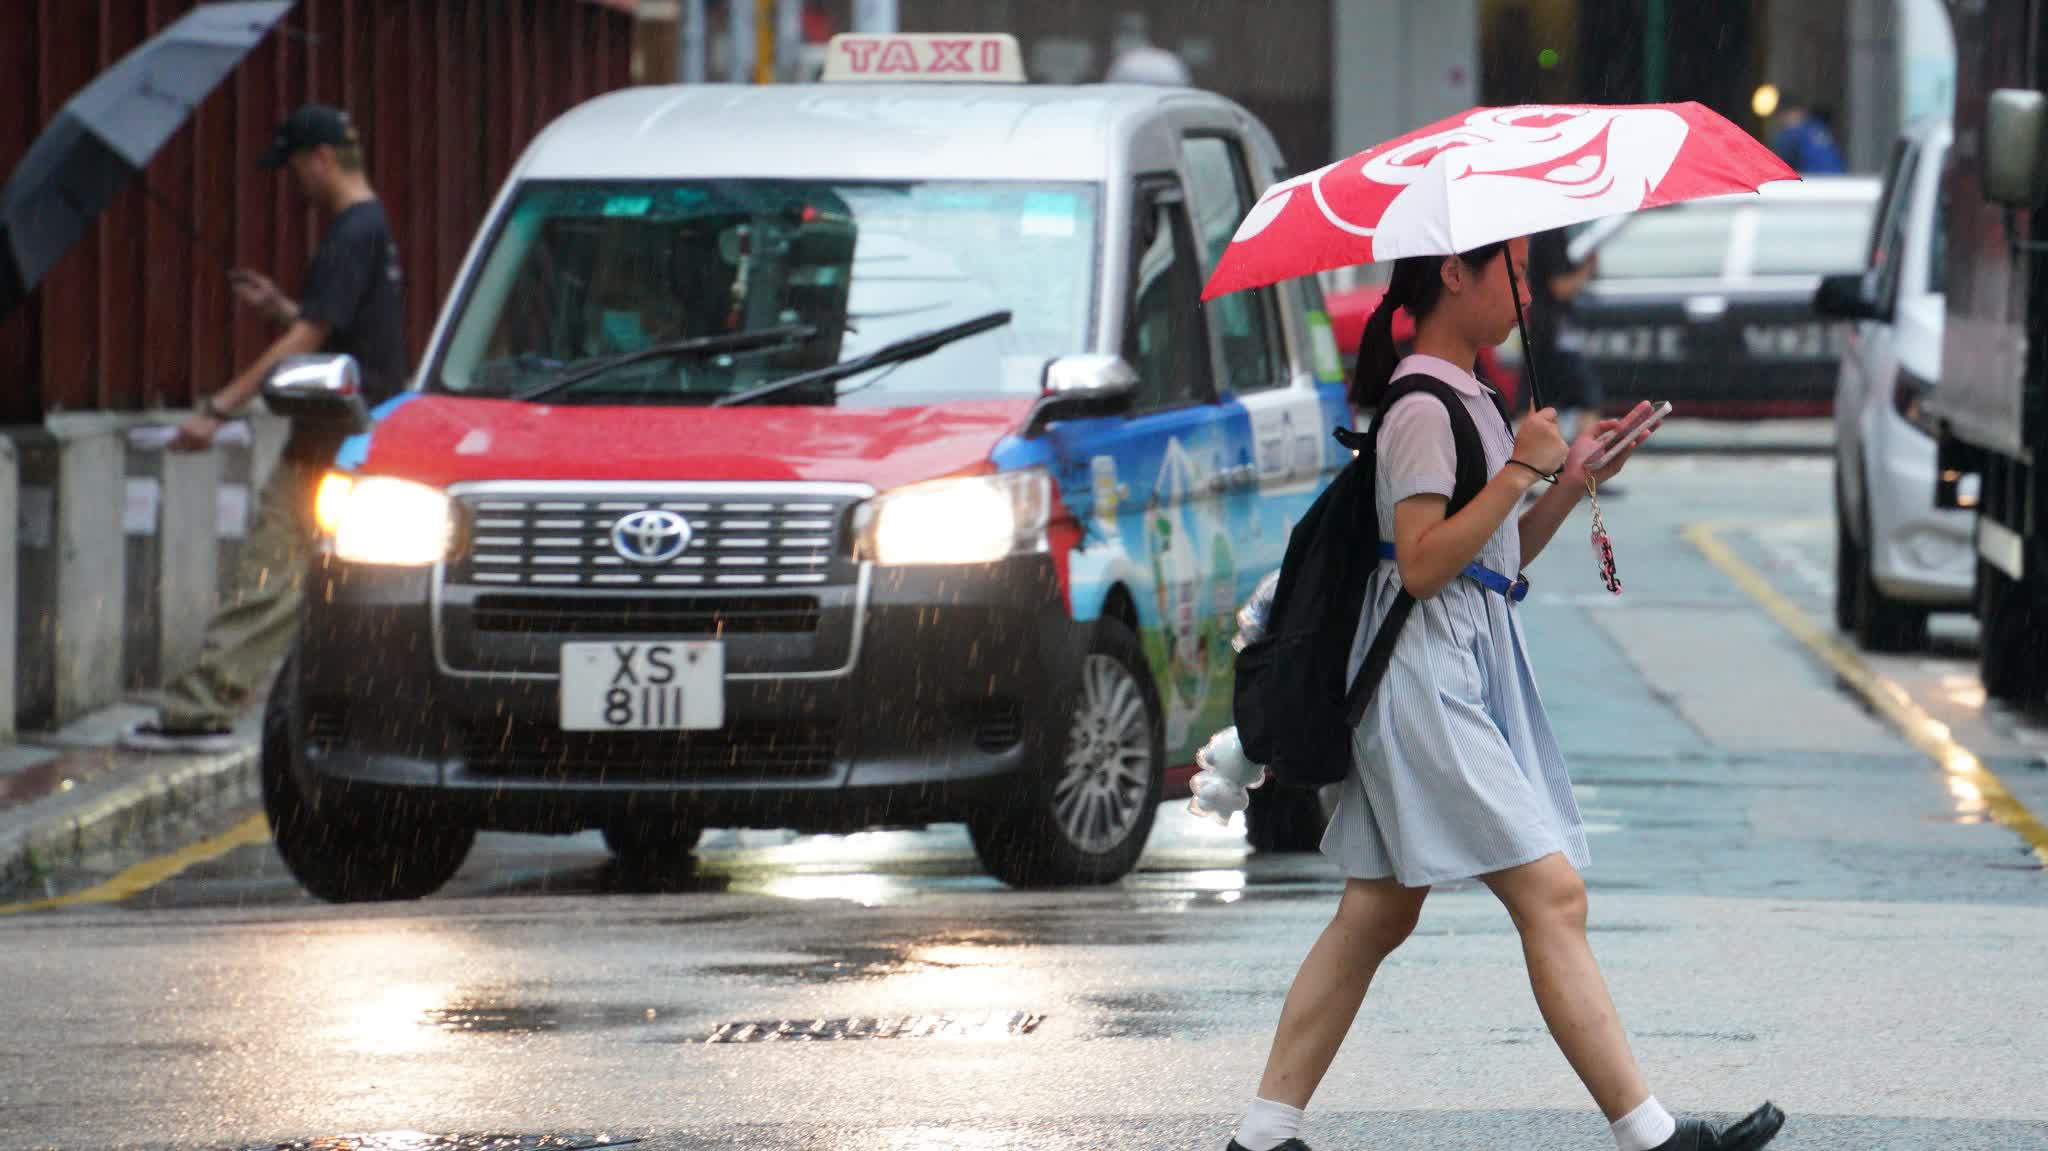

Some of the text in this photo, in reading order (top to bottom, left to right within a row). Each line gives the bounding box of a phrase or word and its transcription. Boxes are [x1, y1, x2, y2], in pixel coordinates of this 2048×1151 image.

[841, 40, 1001, 72] TAXI
[612, 645, 675, 685] XS
[603, 687, 682, 726] 8111
